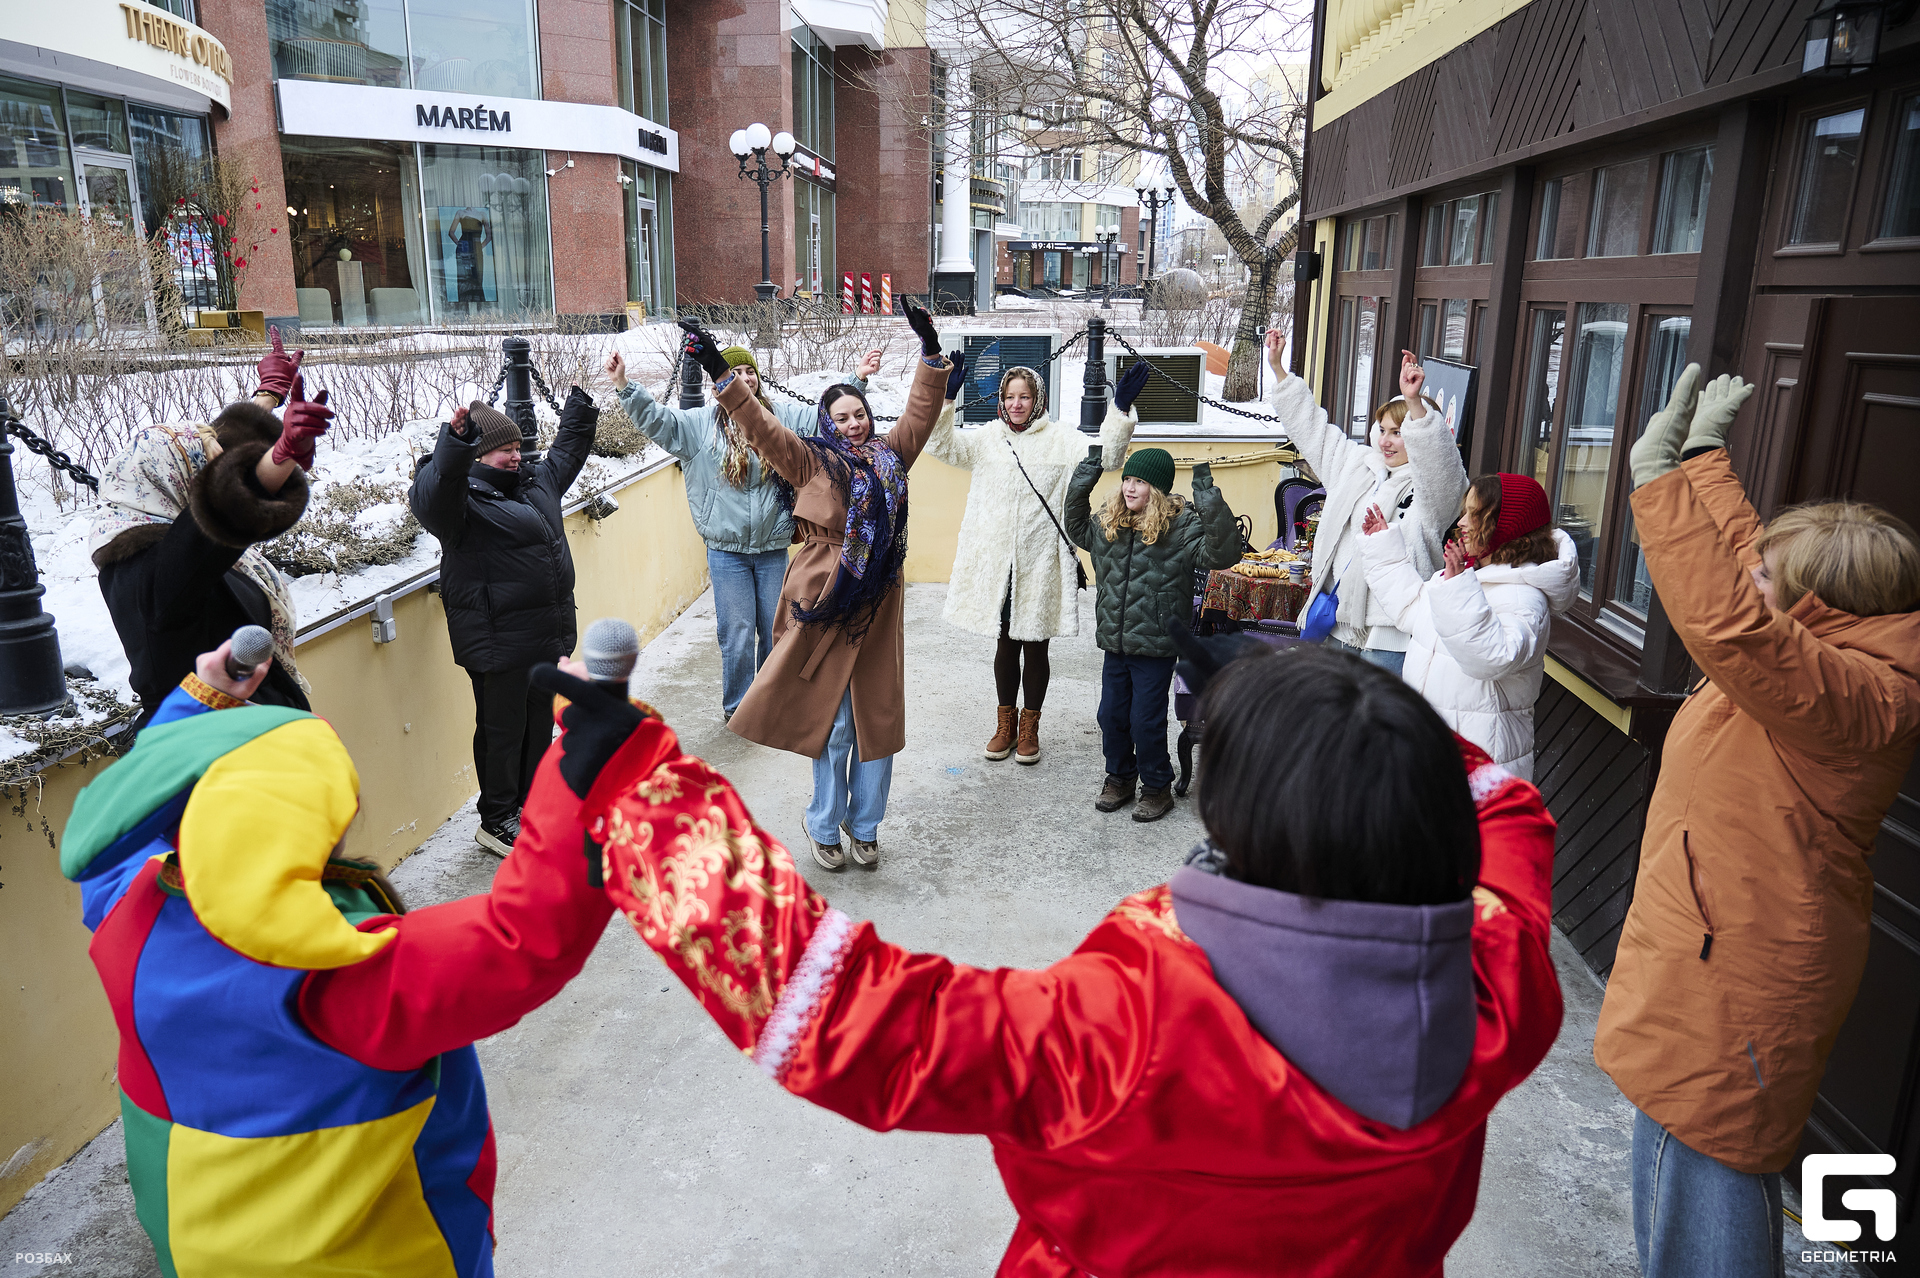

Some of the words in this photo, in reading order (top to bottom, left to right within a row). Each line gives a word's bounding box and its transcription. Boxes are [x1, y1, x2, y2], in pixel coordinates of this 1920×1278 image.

[119, 3, 192, 58] THEATRE
[191, 34, 210, 67] OF
[170, 63, 201, 87] FLOWERS
[416, 103, 511, 132] MARÉM
[1037, 242, 1055, 250] 9:41
